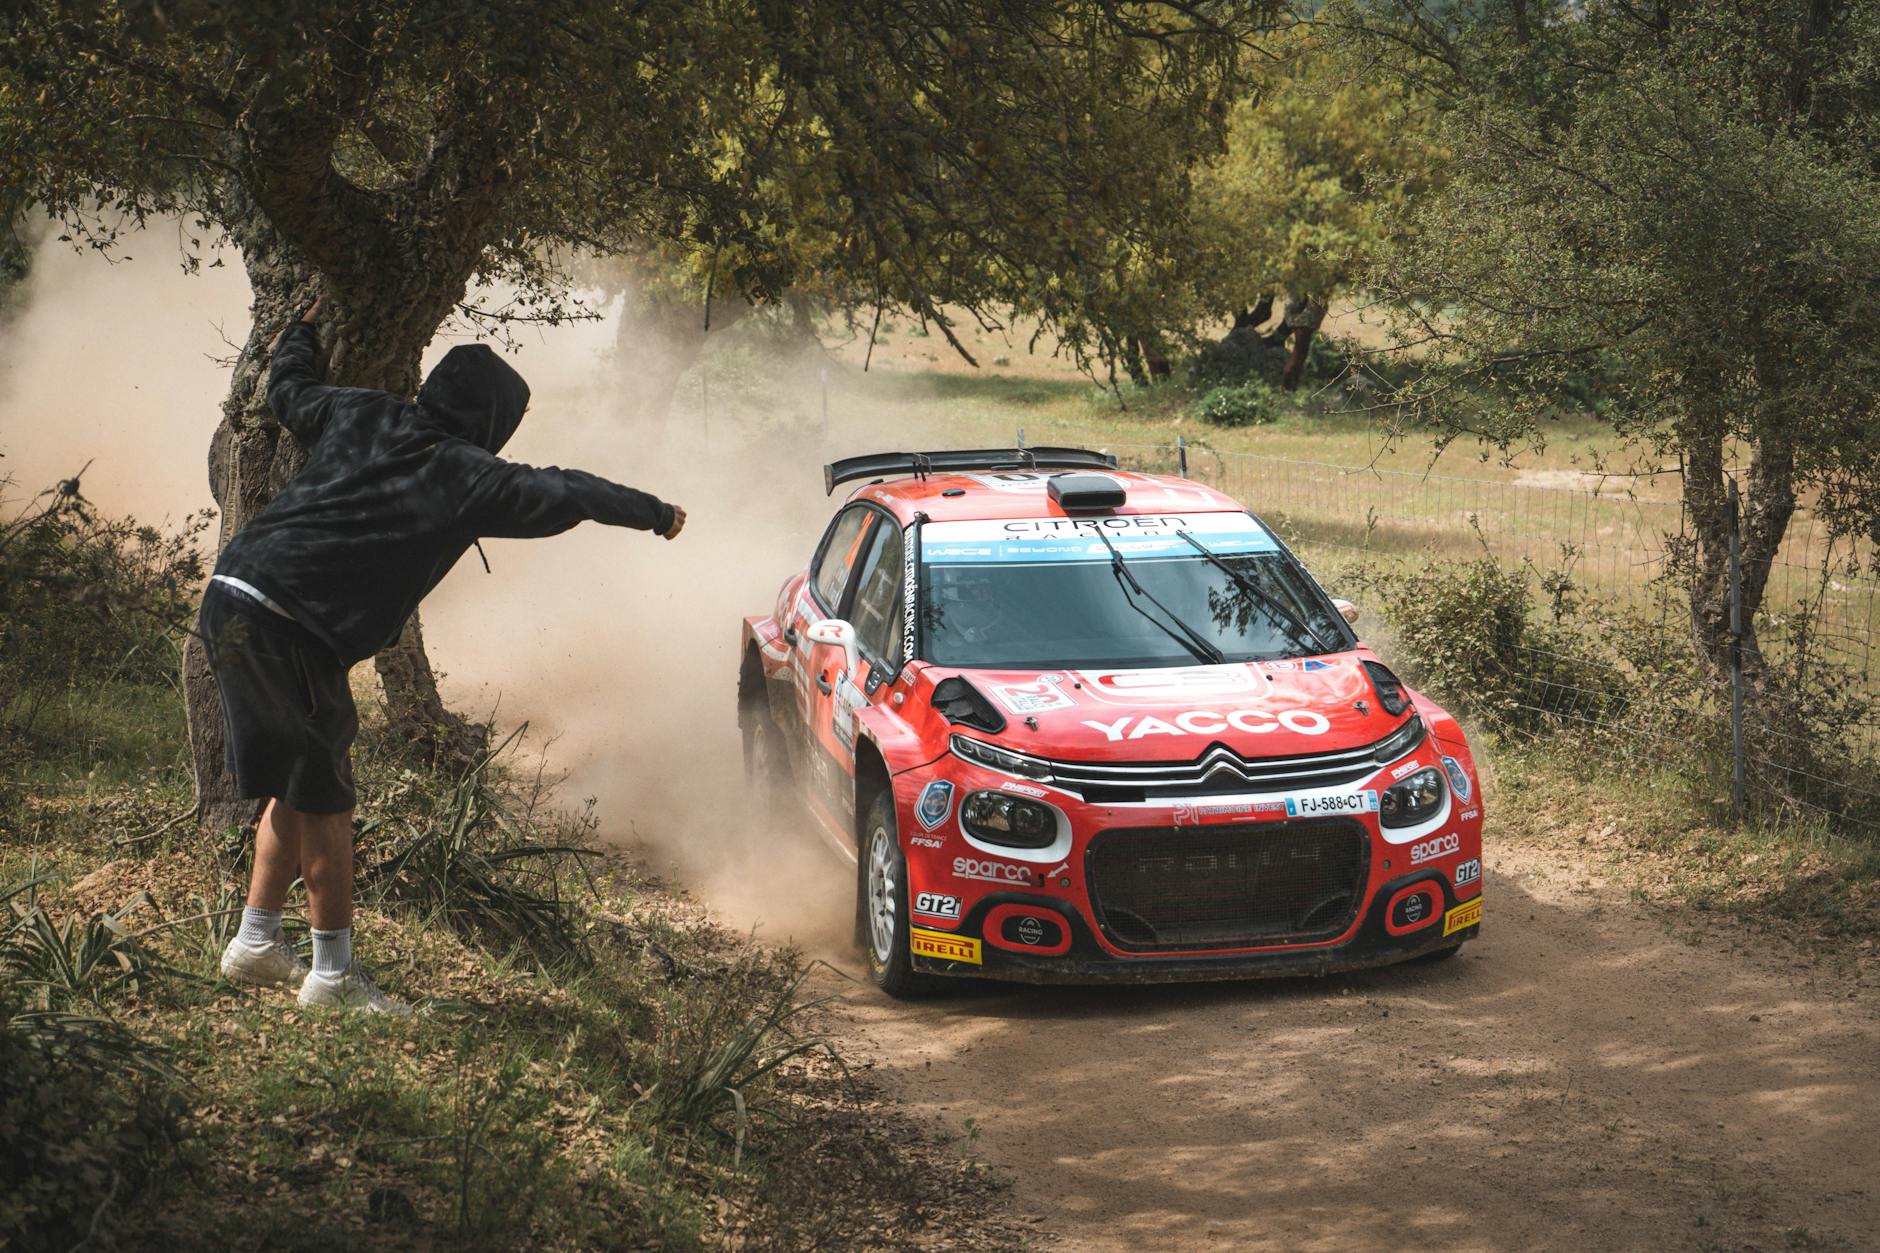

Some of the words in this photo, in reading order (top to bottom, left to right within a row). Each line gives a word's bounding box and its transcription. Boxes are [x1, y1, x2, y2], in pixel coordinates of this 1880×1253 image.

[1080, 710, 1331, 742] YACCO
[1301, 794, 1364, 812] FJ-588-CT
[1411, 833, 1459, 863] sparco
[916, 893, 962, 915] GT2i
